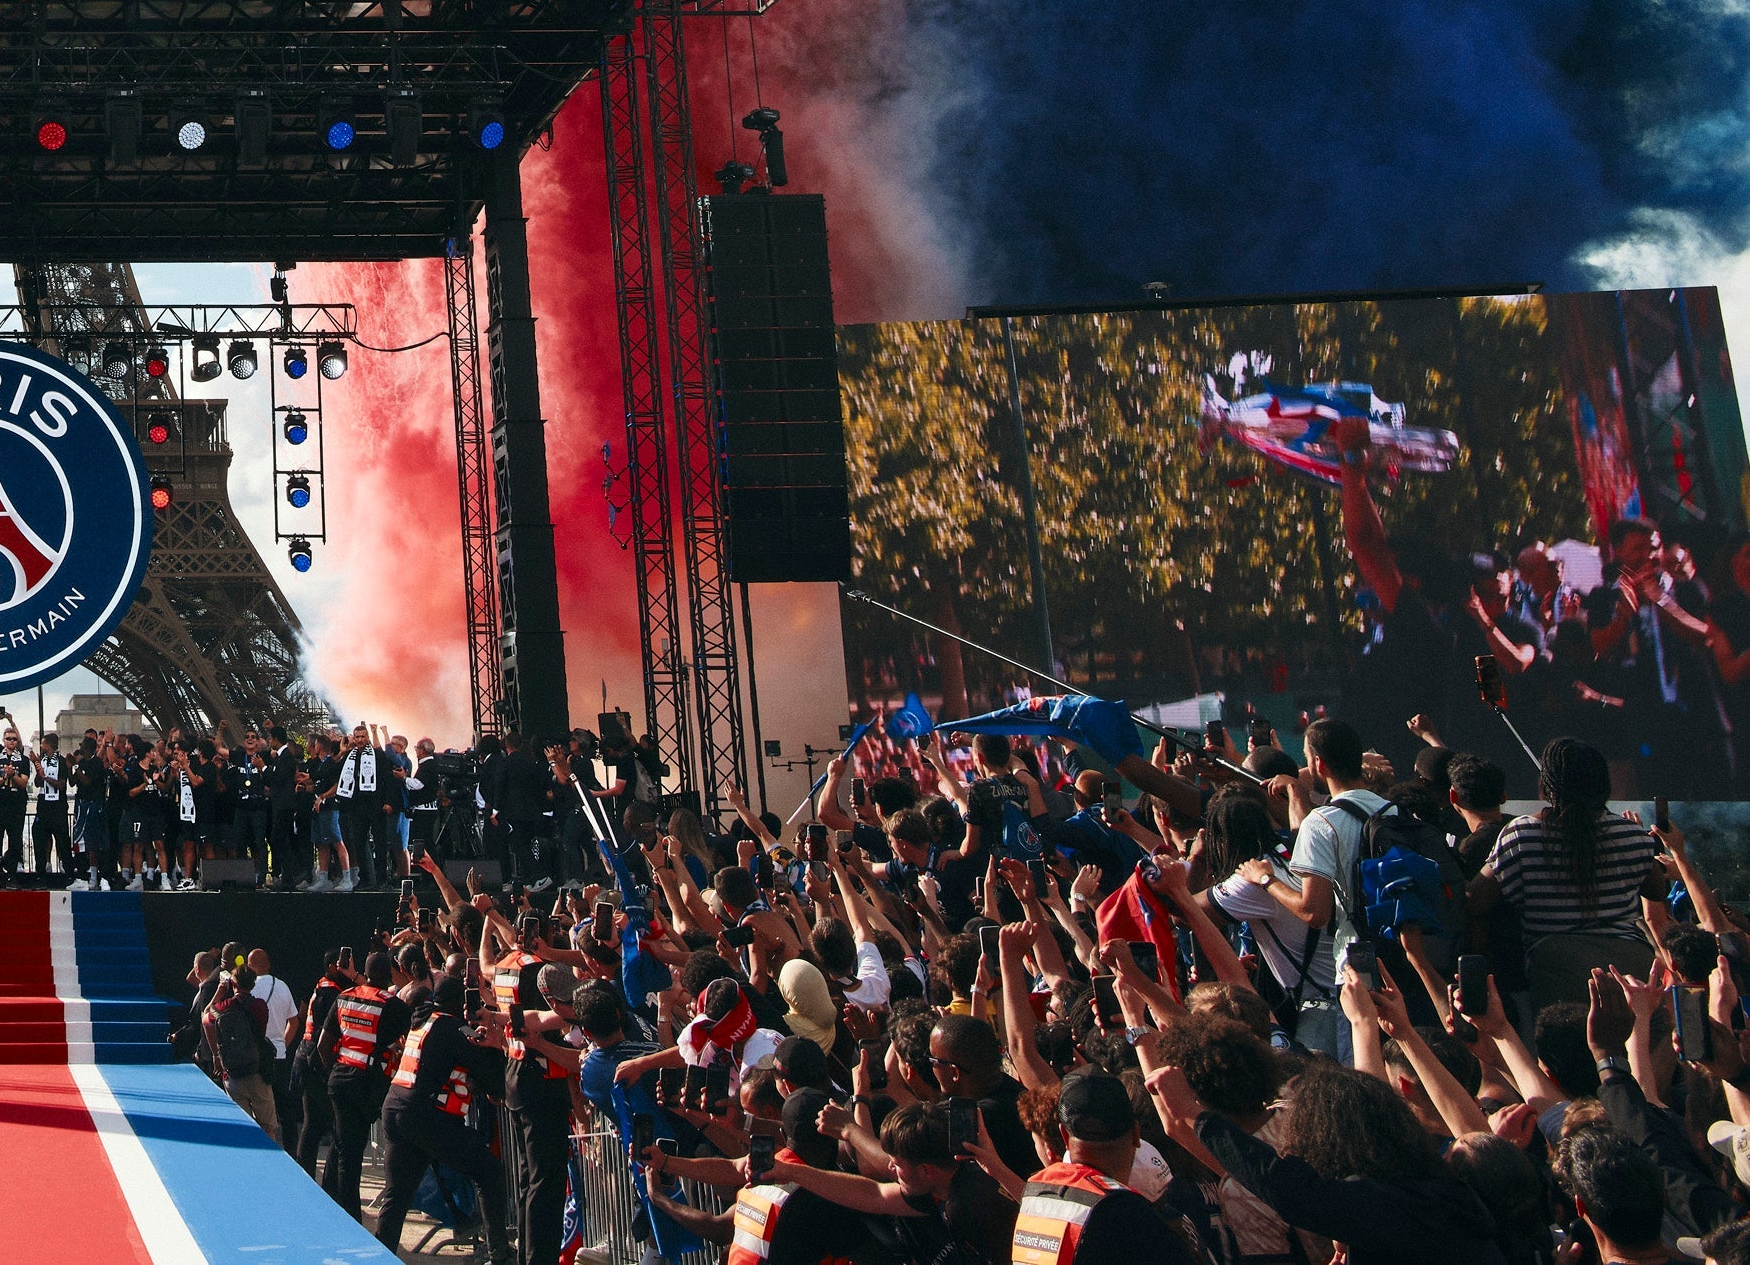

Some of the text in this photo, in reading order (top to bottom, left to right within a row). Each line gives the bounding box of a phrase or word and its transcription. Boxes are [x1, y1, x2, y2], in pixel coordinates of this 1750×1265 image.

[133, 822, 142, 832] 17
[1016, 1233, 1059, 1251] SÉCURITÉ PRIVÉE
